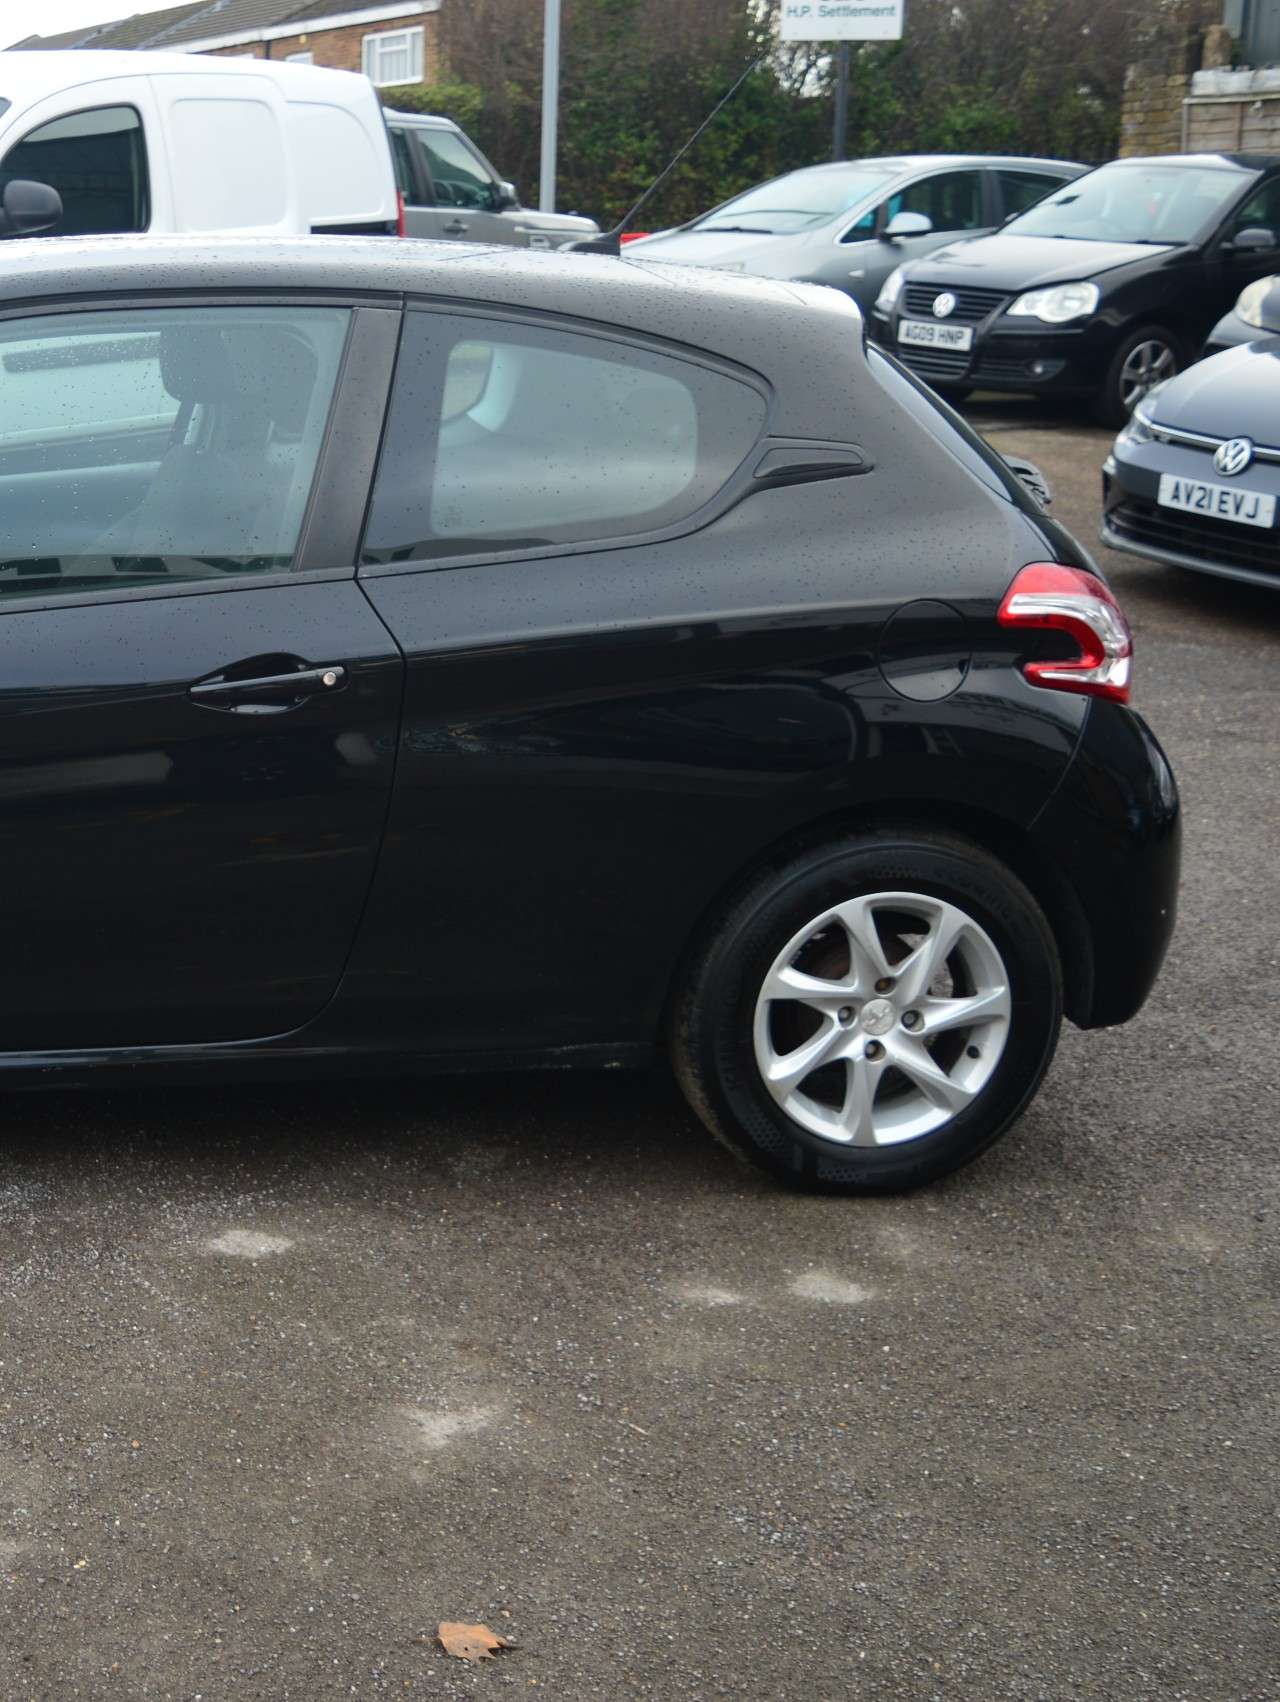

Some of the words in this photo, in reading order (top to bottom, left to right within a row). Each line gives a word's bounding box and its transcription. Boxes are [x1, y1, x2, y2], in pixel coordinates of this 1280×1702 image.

[818, 5, 896, 17] Settlement
[1171, 479, 1214, 510] AV21
[1218, 490, 1261, 519] EVJ
